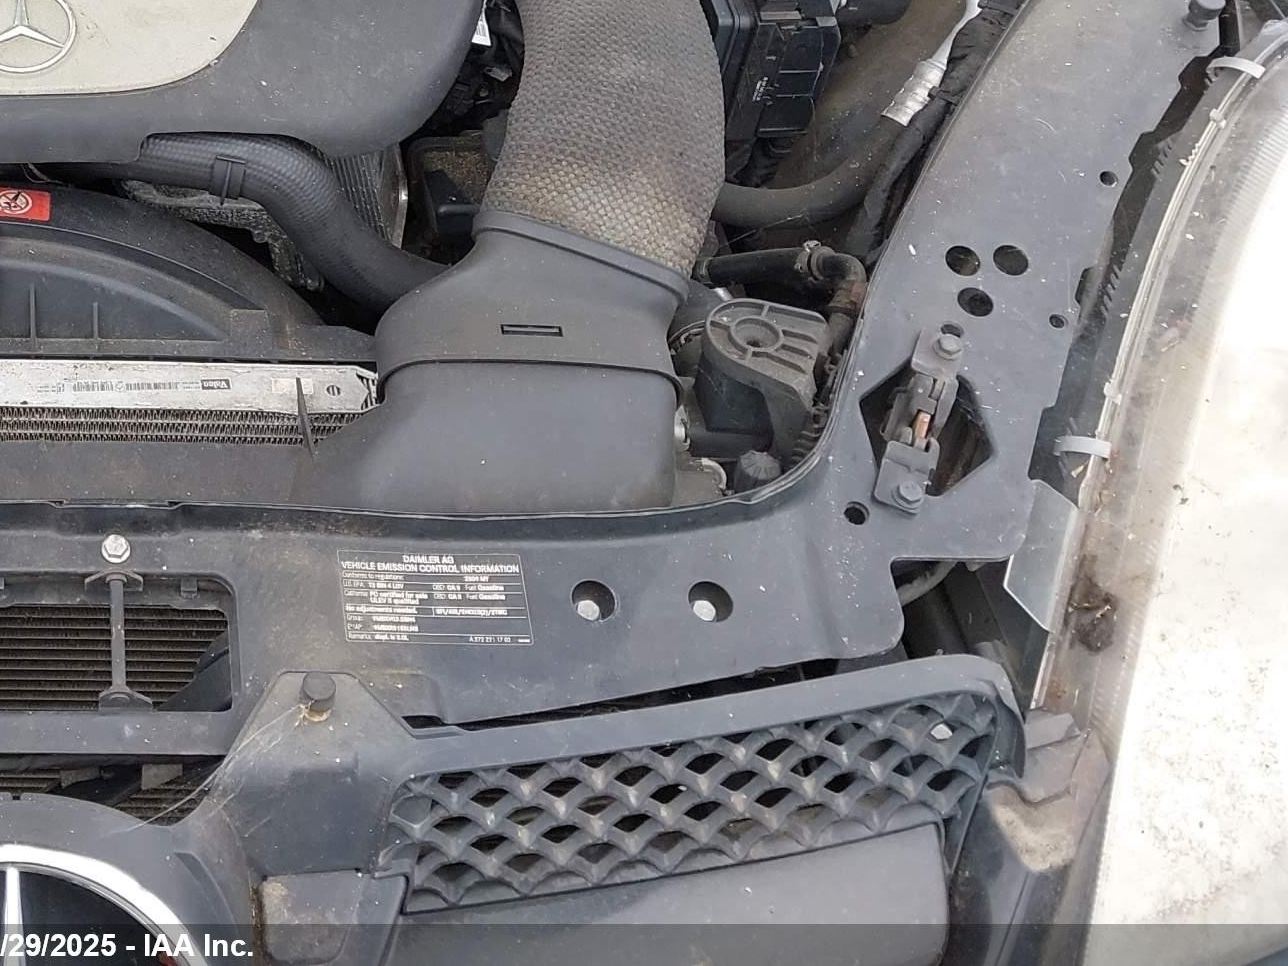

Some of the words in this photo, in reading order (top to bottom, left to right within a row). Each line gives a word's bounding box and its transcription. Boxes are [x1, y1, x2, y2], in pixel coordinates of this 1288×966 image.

[402, 555, 440, 563] DAIMLER
[441, 556, 454, 564] AG
[342, 561, 375, 570] VEHICLE
[377, 562, 417, 572] EMISSION
[419, 564, 459, 573] CONTROL
[461, 565, 519, 573] INFORMATION
